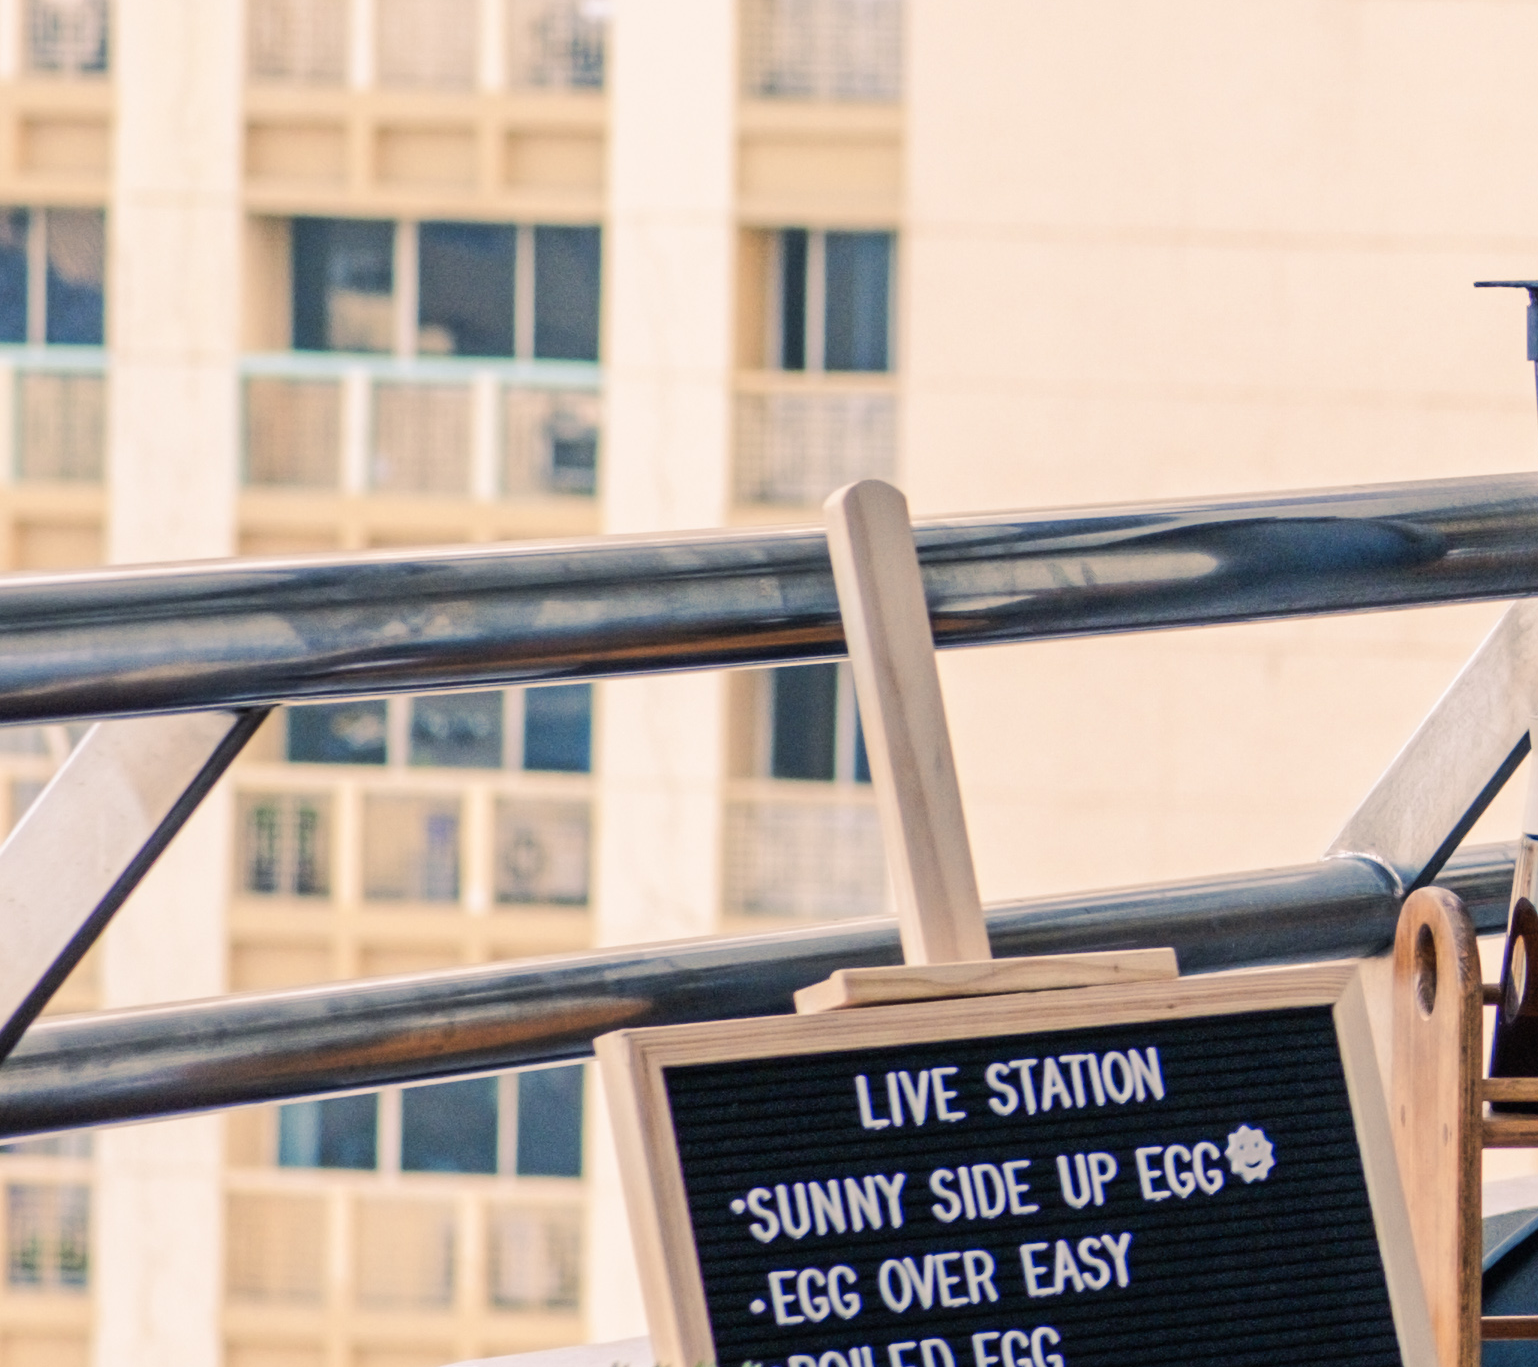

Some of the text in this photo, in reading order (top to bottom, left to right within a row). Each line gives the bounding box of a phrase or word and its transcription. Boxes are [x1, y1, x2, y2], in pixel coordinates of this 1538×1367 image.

[856, 1046, 1165, 1130] LIVE STATION
[747, 1140, 1226, 1244] SUNNY SIDE UP EGG
[768, 1232, 1133, 1326] EGG OVER EASY
